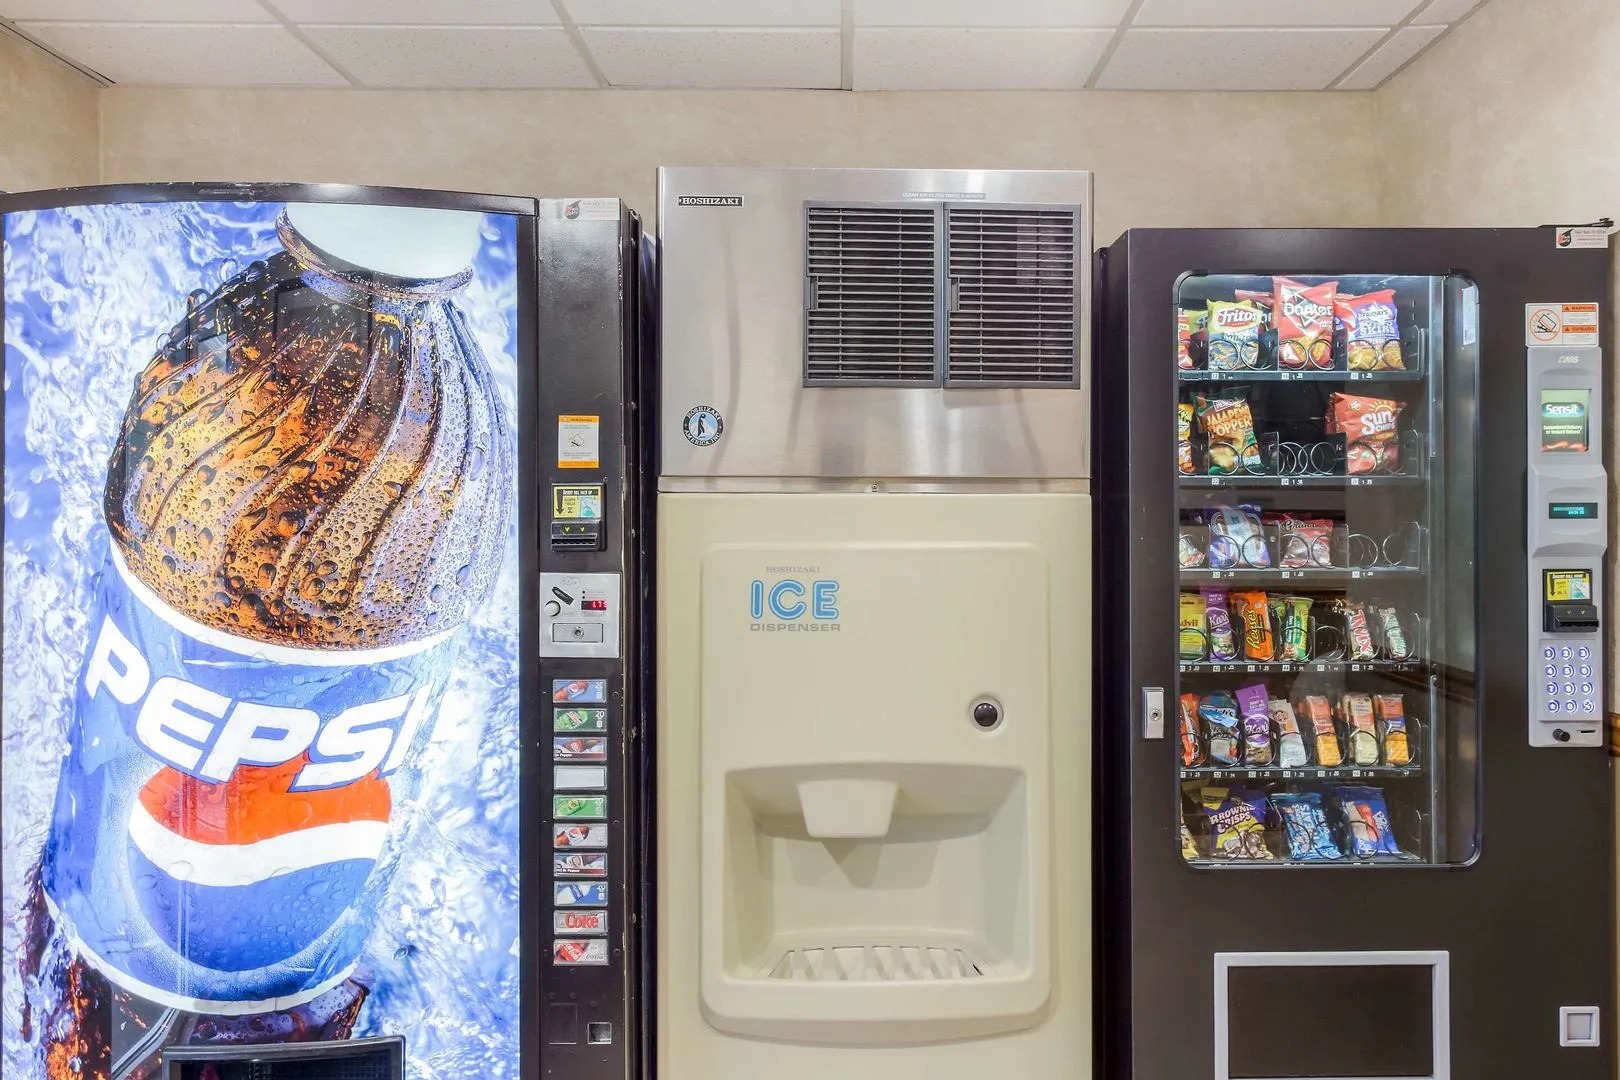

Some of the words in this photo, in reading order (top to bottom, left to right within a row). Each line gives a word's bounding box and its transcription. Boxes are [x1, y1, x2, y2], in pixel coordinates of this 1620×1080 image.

[682, 197, 740, 205] HOSHIZAKI
[1546, 404, 1579, 414] Sensit
[1360, 410, 1396, 435] Sun
[751, 580, 840, 620] ICE
[750, 624, 841, 632] DISPENSER
[1246, 609, 1260, 650] Reese's
[84, 614, 434, 788] PEPSI
[1218, 812, 1252, 833] CRISPS
[564, 912, 599, 928] Coke
